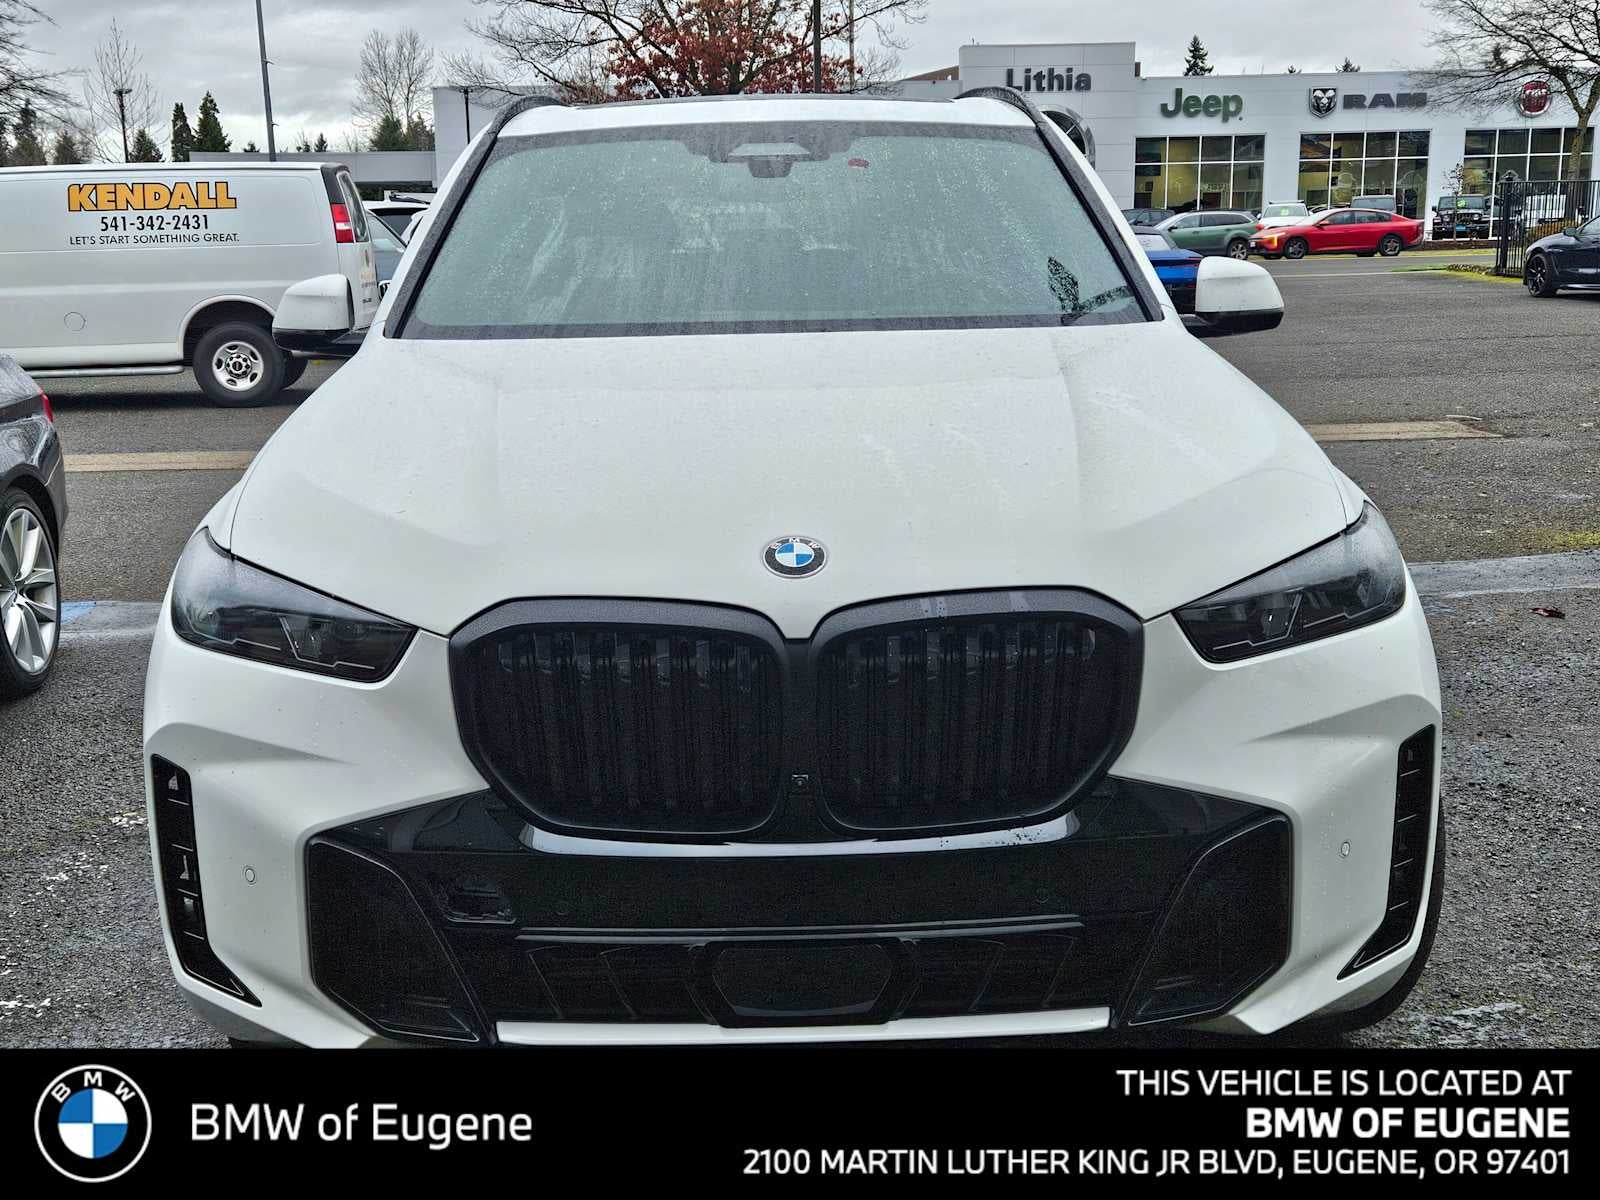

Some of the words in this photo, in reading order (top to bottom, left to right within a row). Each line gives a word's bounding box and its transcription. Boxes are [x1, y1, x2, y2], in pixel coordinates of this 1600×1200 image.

[1006, 68, 1092, 92] Lithia
[1160, 87, 1243, 123] Jeep
[1343, 92, 1428, 110] RAM
[67, 181, 238, 212] KENDALL
[100, 214, 209, 232] 541-342-2431
[69, 235, 96, 245] LET'S
[99, 235, 130, 245] START
[133, 233, 200, 244] SOMETHING
[203, 232, 240, 243] GREAT.
